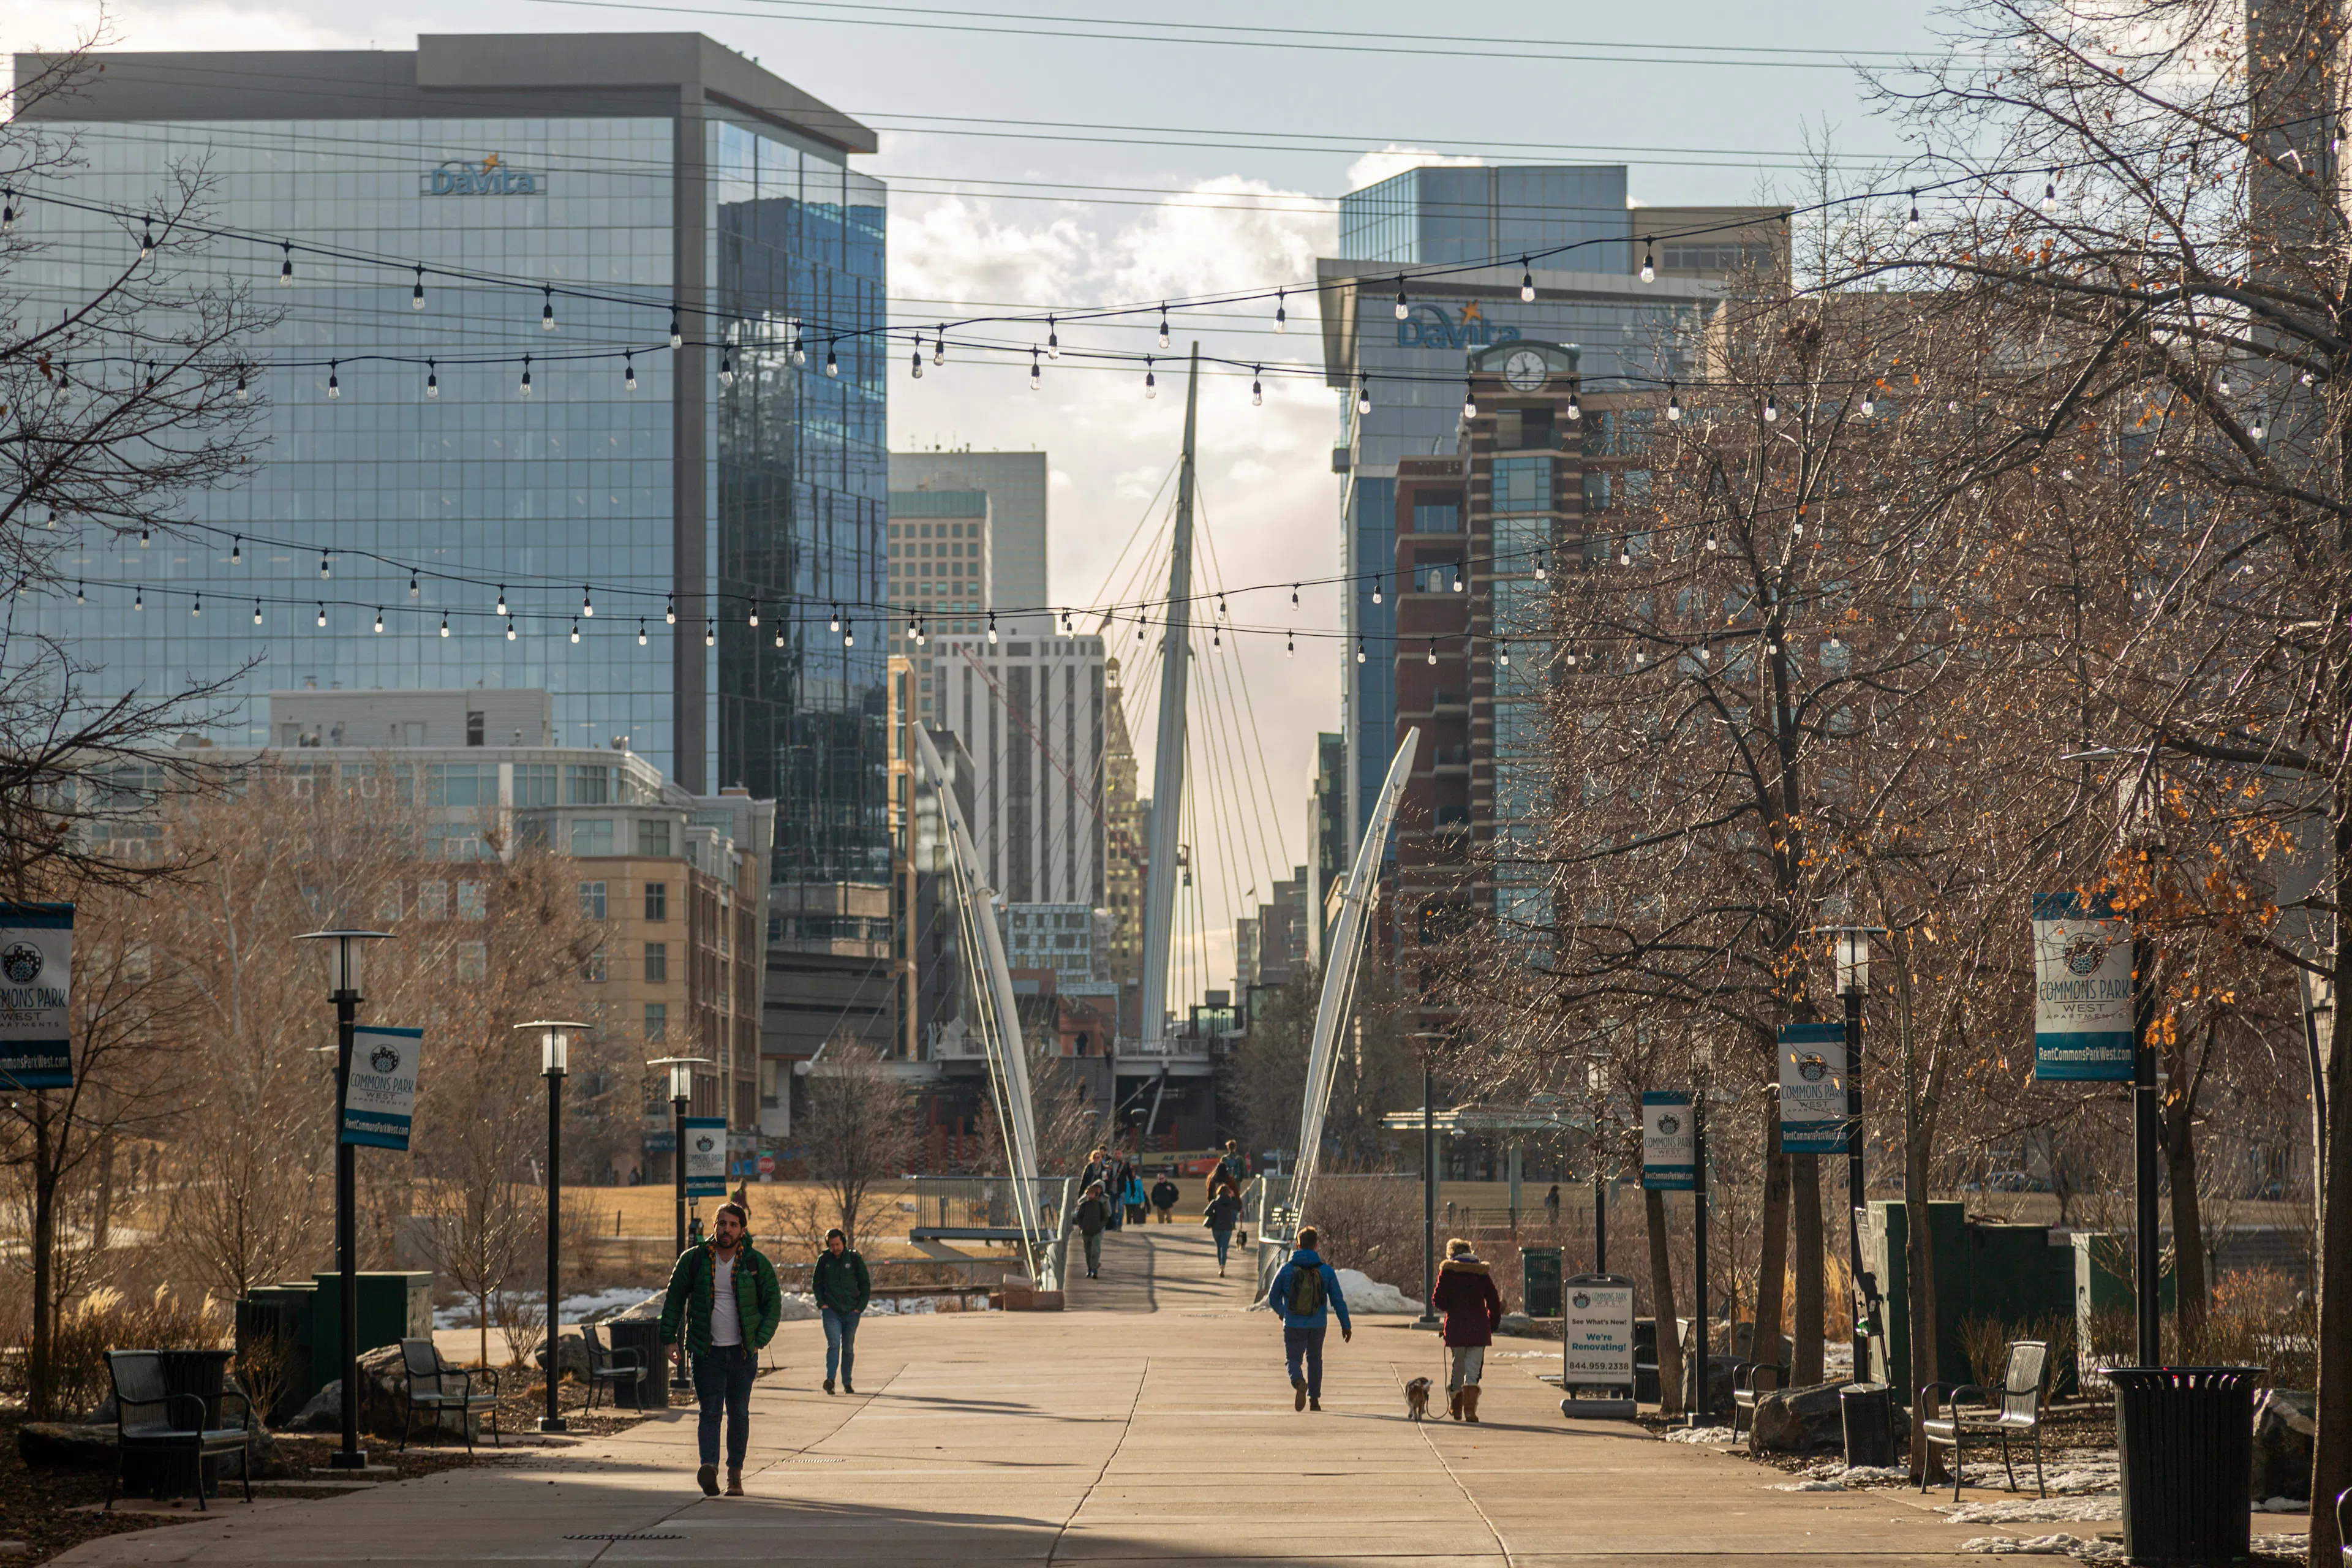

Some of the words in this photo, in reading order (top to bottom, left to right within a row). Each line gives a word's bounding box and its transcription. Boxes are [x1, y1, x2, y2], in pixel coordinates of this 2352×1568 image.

[431, 160, 535, 195] DaVita
[1398, 304, 1521, 349] DaVita
[2040, 979, 2096, 1001] COMMONS
[2100, 979, 2130, 1000] PARK
[1, 988, 34, 1008] MONS
[37, 988, 66, 1008] PARK
[2063, 1004, 2105, 1012] WEST
[1, 1012, 42, 1021] WEST
[2039, 1046, 2132, 1061] RentCommonsParkWest.com
[350, 1072, 391, 1091] COMMONS
[394, 1077, 414, 1093] PARK
[366, 1091, 396, 1100] WEST
[1782, 1085, 1822, 1099] COMMONS
[1825, 1084, 1845, 1098] PARK
[353, 1097, 407, 1106] APARTMENTS
[345, 1118, 409, 1136] RentCommonsParkWest.com
[1783, 1130, 1847, 1140] RentCommonsParkWest.com
[1645, 1137, 1676, 1148] COMMONS
[1678, 1137, 1693, 1148] PARK
[686, 1154, 710, 1163] COMMONS
[712, 1153, 724, 1162] PARK
[1592, 1292, 1615, 1301] COMMONS
[1616, 1292, 1627, 1300] PARK
[1572, 1343, 1627, 1352] Renovating!
